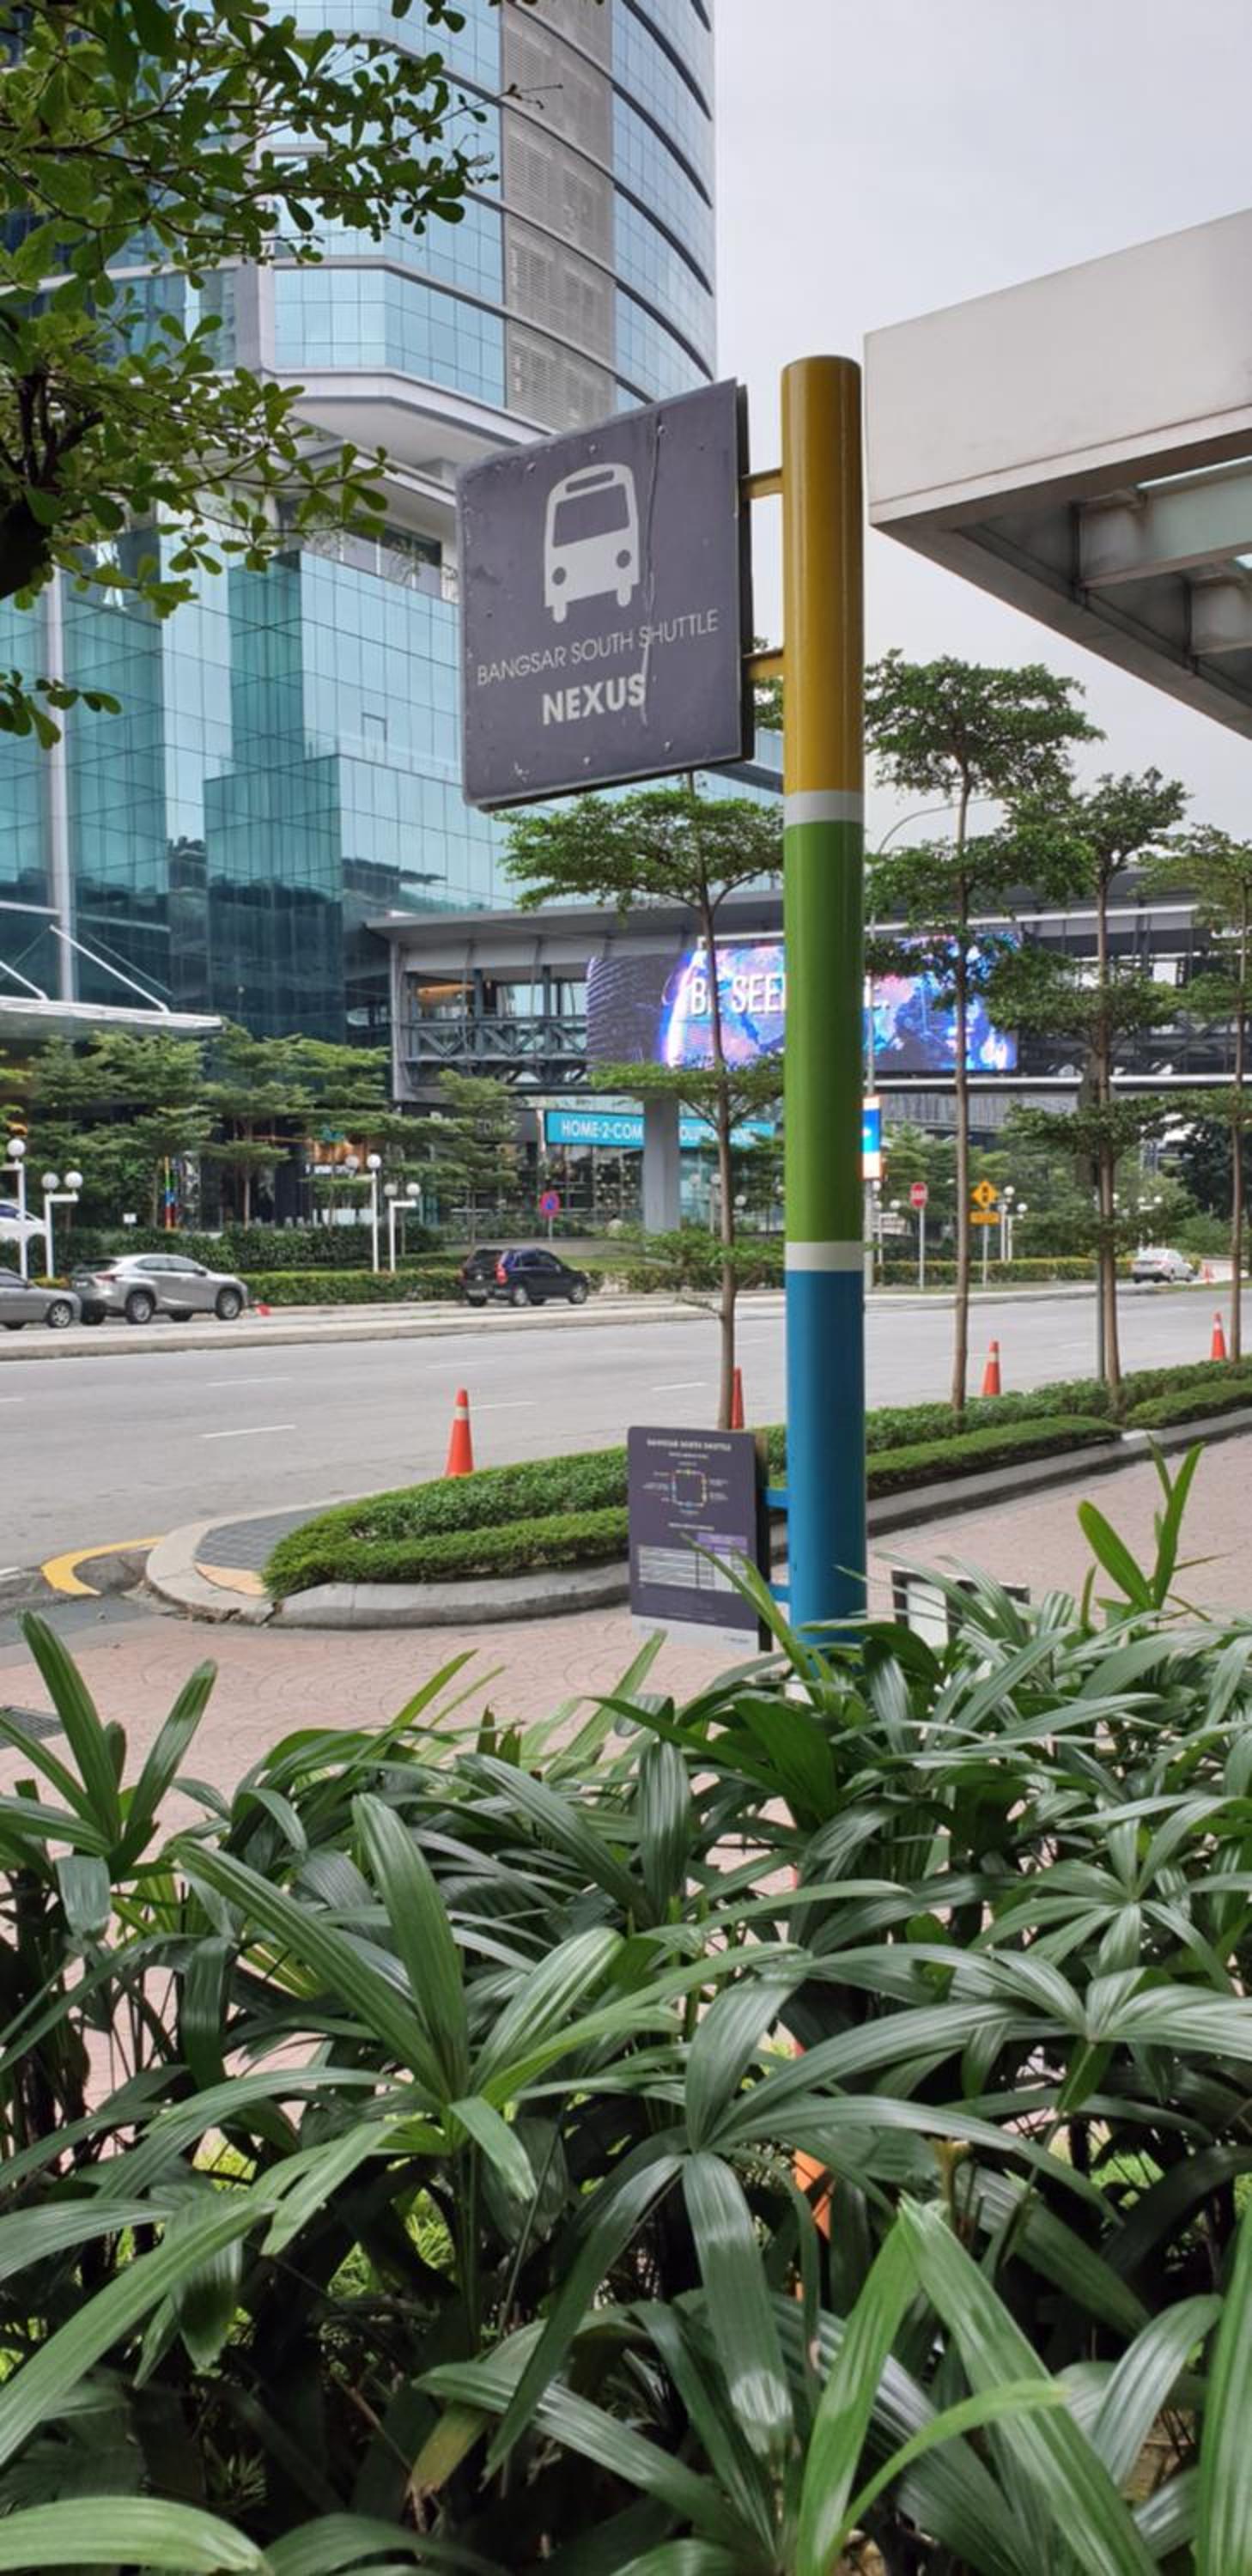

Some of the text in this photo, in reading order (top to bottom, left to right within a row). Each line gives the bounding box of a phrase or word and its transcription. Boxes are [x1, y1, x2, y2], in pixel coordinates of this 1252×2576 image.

[477, 609, 719, 686] BANGSAR SOUTH SHUTTLE
[542, 673, 646, 726] NEXUS
